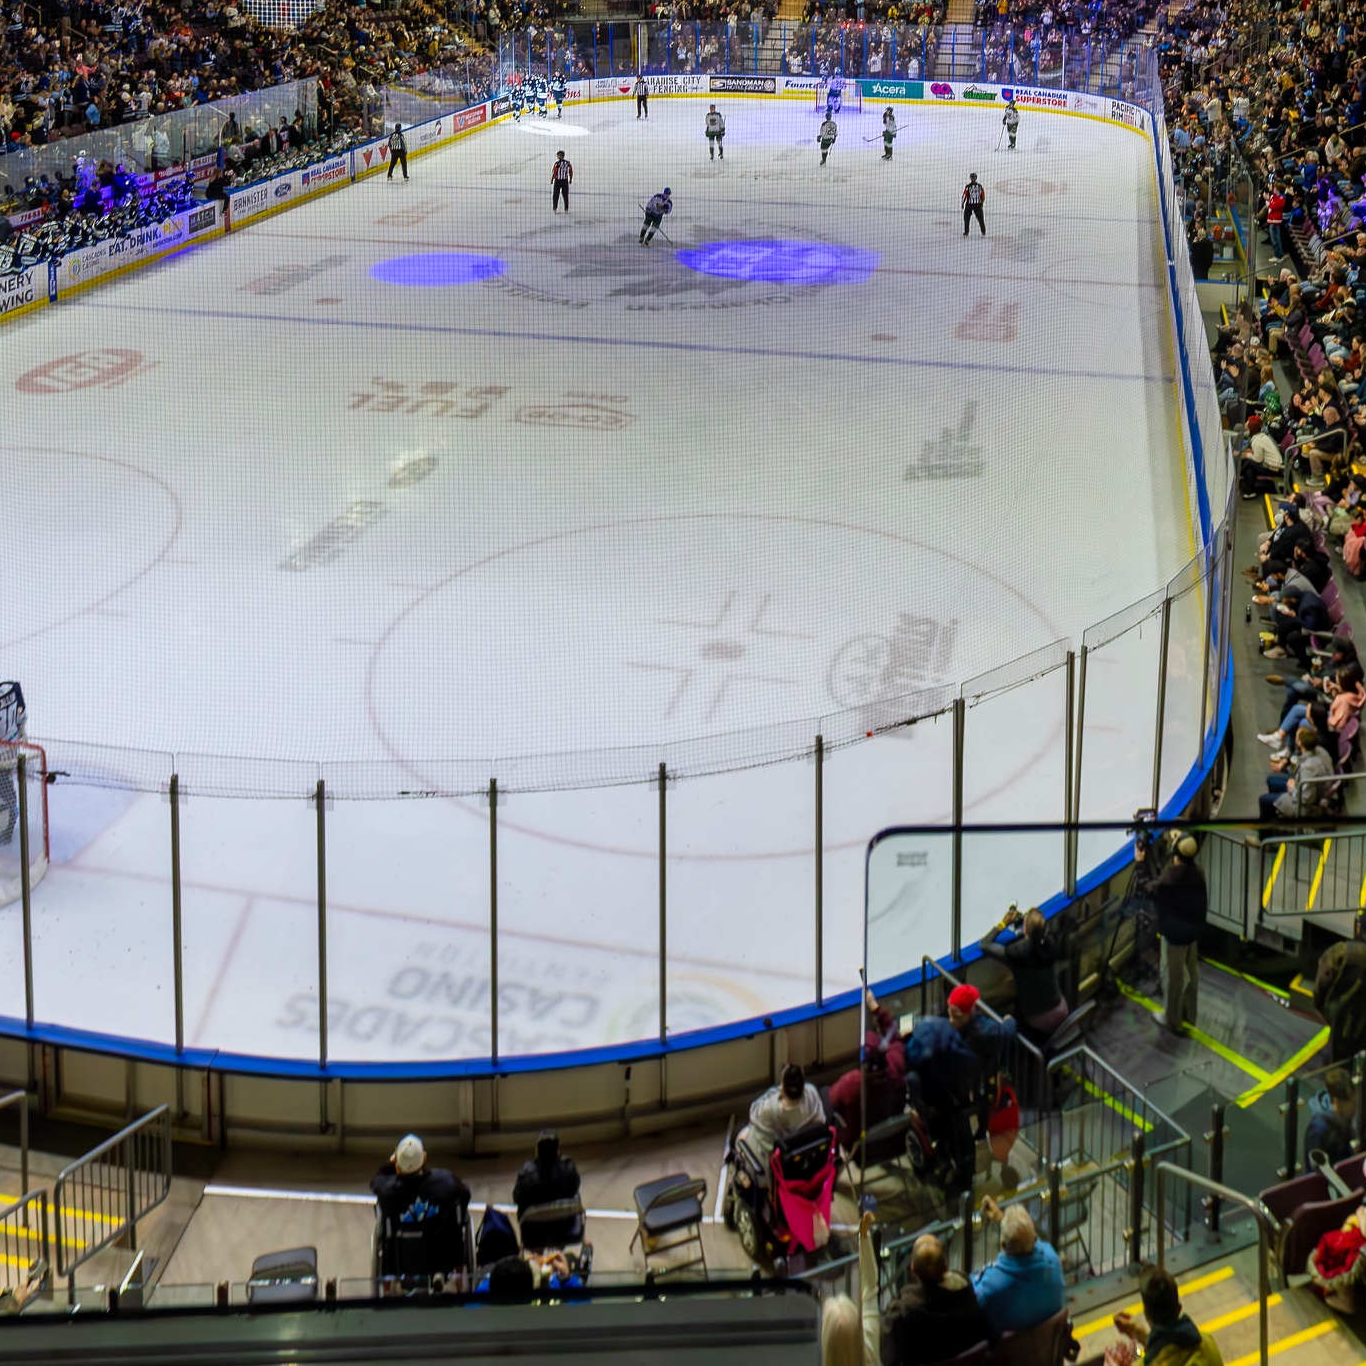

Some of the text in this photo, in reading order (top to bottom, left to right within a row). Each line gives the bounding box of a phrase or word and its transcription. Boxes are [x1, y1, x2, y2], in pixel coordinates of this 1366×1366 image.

[683, 77, 702, 85] CITY
[727, 79, 763, 87] SANDMAN
[653, 84, 688, 93] FENCING
[876, 83, 905, 95] Acera
[1015, 89, 1067, 100] REAL CANADIAN
[1015, 95, 1067, 107] SUPERSTORE
[1112, 101, 1134, 116] PACIFIC
[1112, 110, 1123, 121] RIM
[234, 188, 268, 211] BANNISTER
[82, 248, 106, 264] CASCADES
[388, 966, 602, 1029] CASINO
